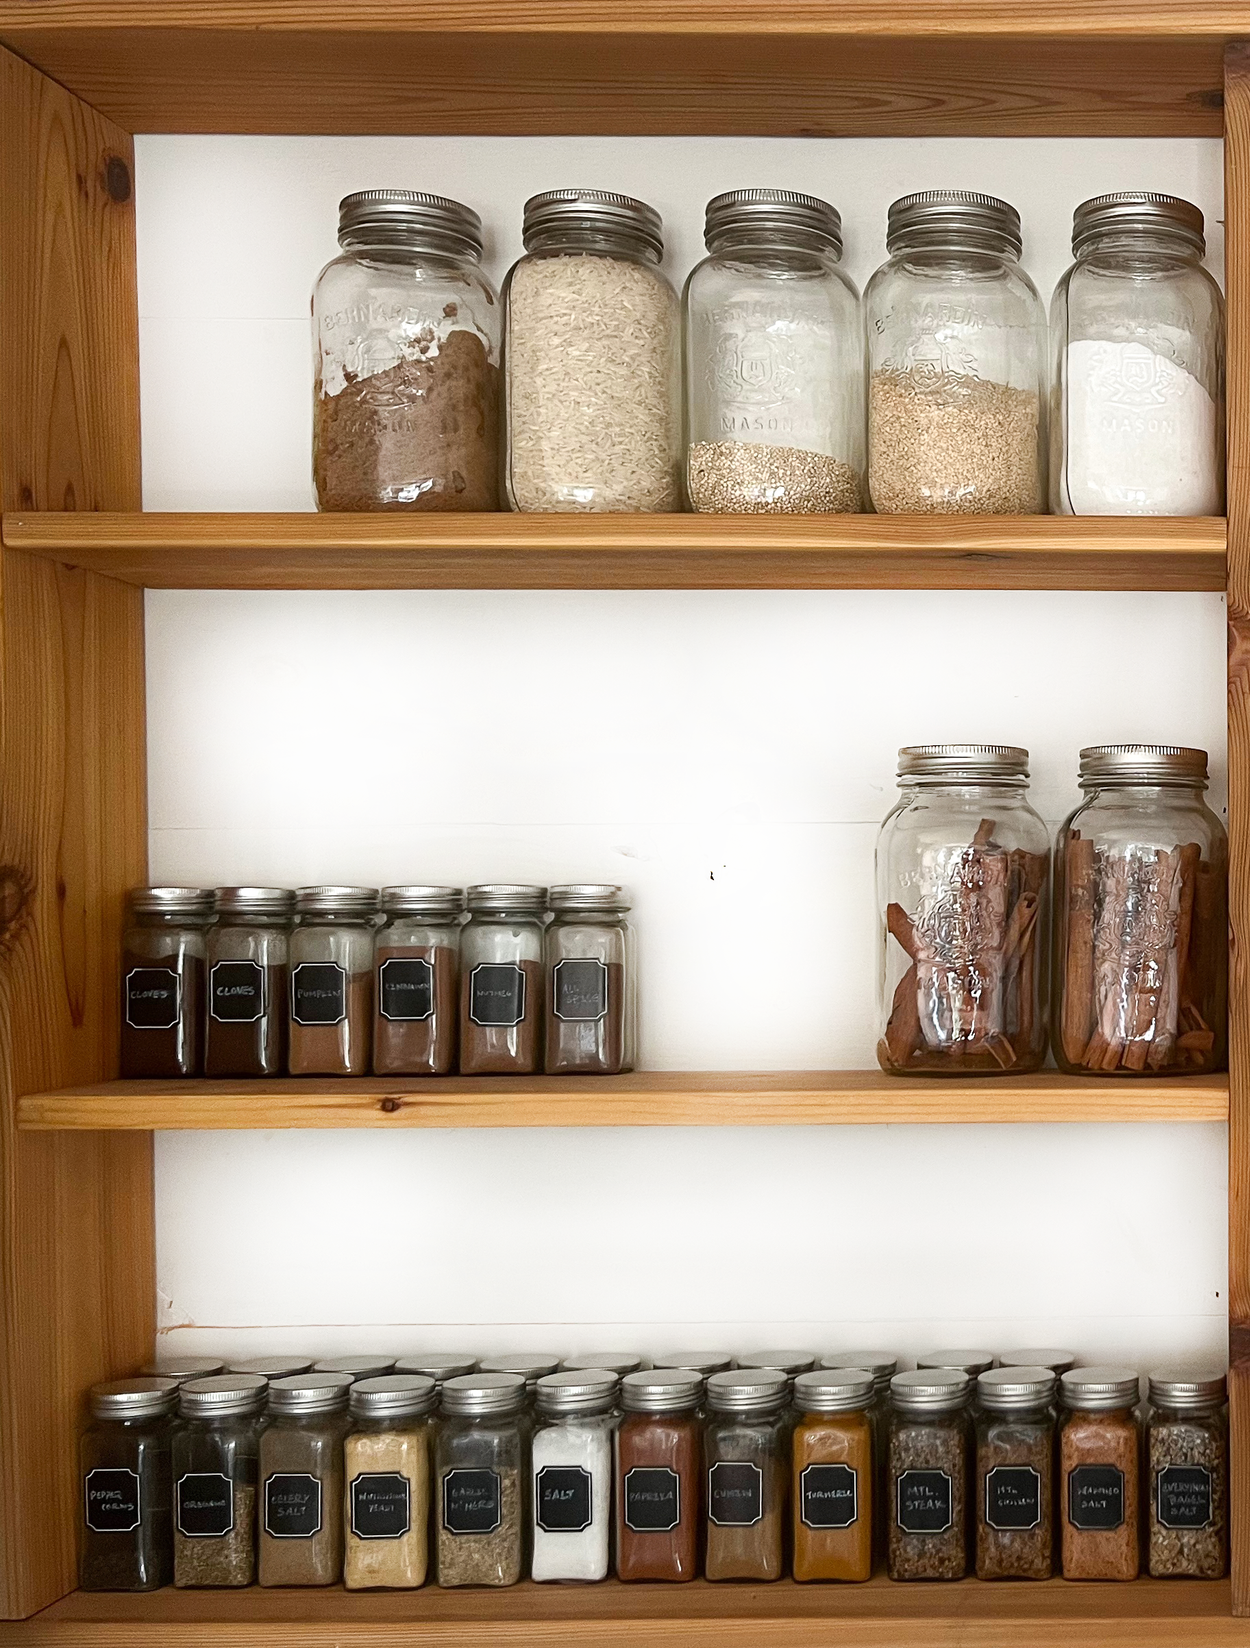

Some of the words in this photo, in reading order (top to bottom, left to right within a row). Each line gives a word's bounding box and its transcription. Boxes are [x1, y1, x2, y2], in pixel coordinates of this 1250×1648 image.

[719, 415, 794, 433] MASON
[1101, 416, 1175, 434] MASON
[130, 989, 169, 999] CLOVES
[216, 985, 255, 997] CLOVES
[297, 988, 342, 999] PUMPKIN
[476, 989, 512, 998] NUTMEG
[543, 1488, 575, 1501] SALT
[629, 1490, 674, 1502] PAPRIKA
[713, 1487, 752, 1499] CUMIN
[805, 1489, 854, 1500] TURMERIC
[907, 1485, 939, 1496] MTL.
[271, 1493, 311, 1505] CELERY
[905, 1498, 947, 1511] STEAK
[276, 1505, 308, 1517] SALT
